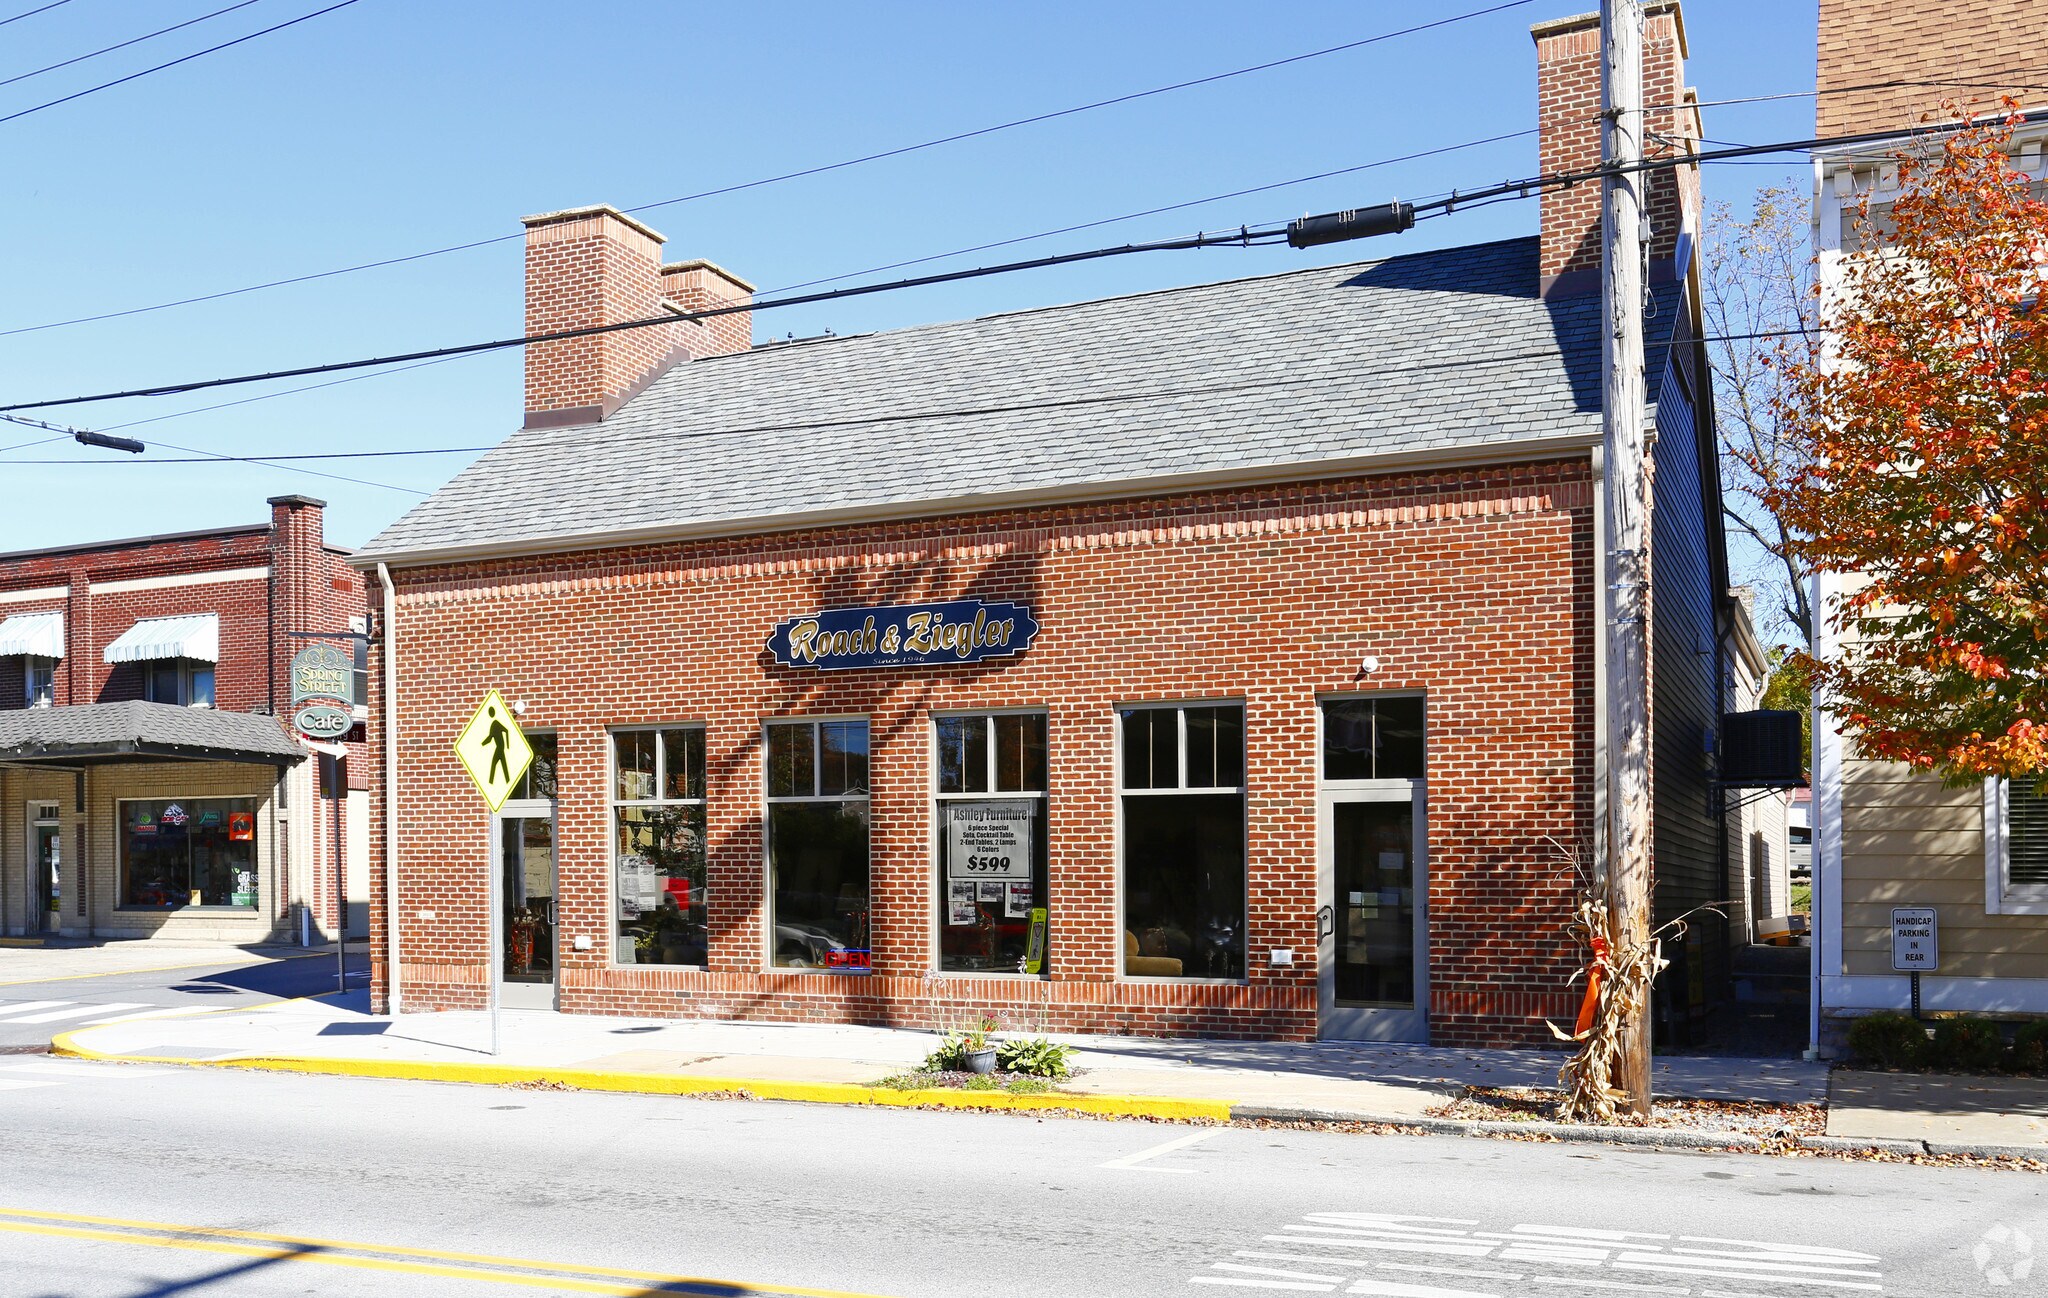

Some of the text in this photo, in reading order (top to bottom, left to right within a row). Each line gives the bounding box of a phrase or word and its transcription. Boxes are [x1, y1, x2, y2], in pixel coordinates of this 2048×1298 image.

[788, 607, 1014, 663] Roach & Ziegler
[872, 656, 900, 664] Since
[300, 667, 343, 681] SPRING
[298, 679, 346, 693] STREET
[301, 713, 344, 730] Café
[954, 808, 1027, 822] Ashley Furniture
[967, 855, 1010, 871] $599
[825, 951, 870, 966] OPEN
